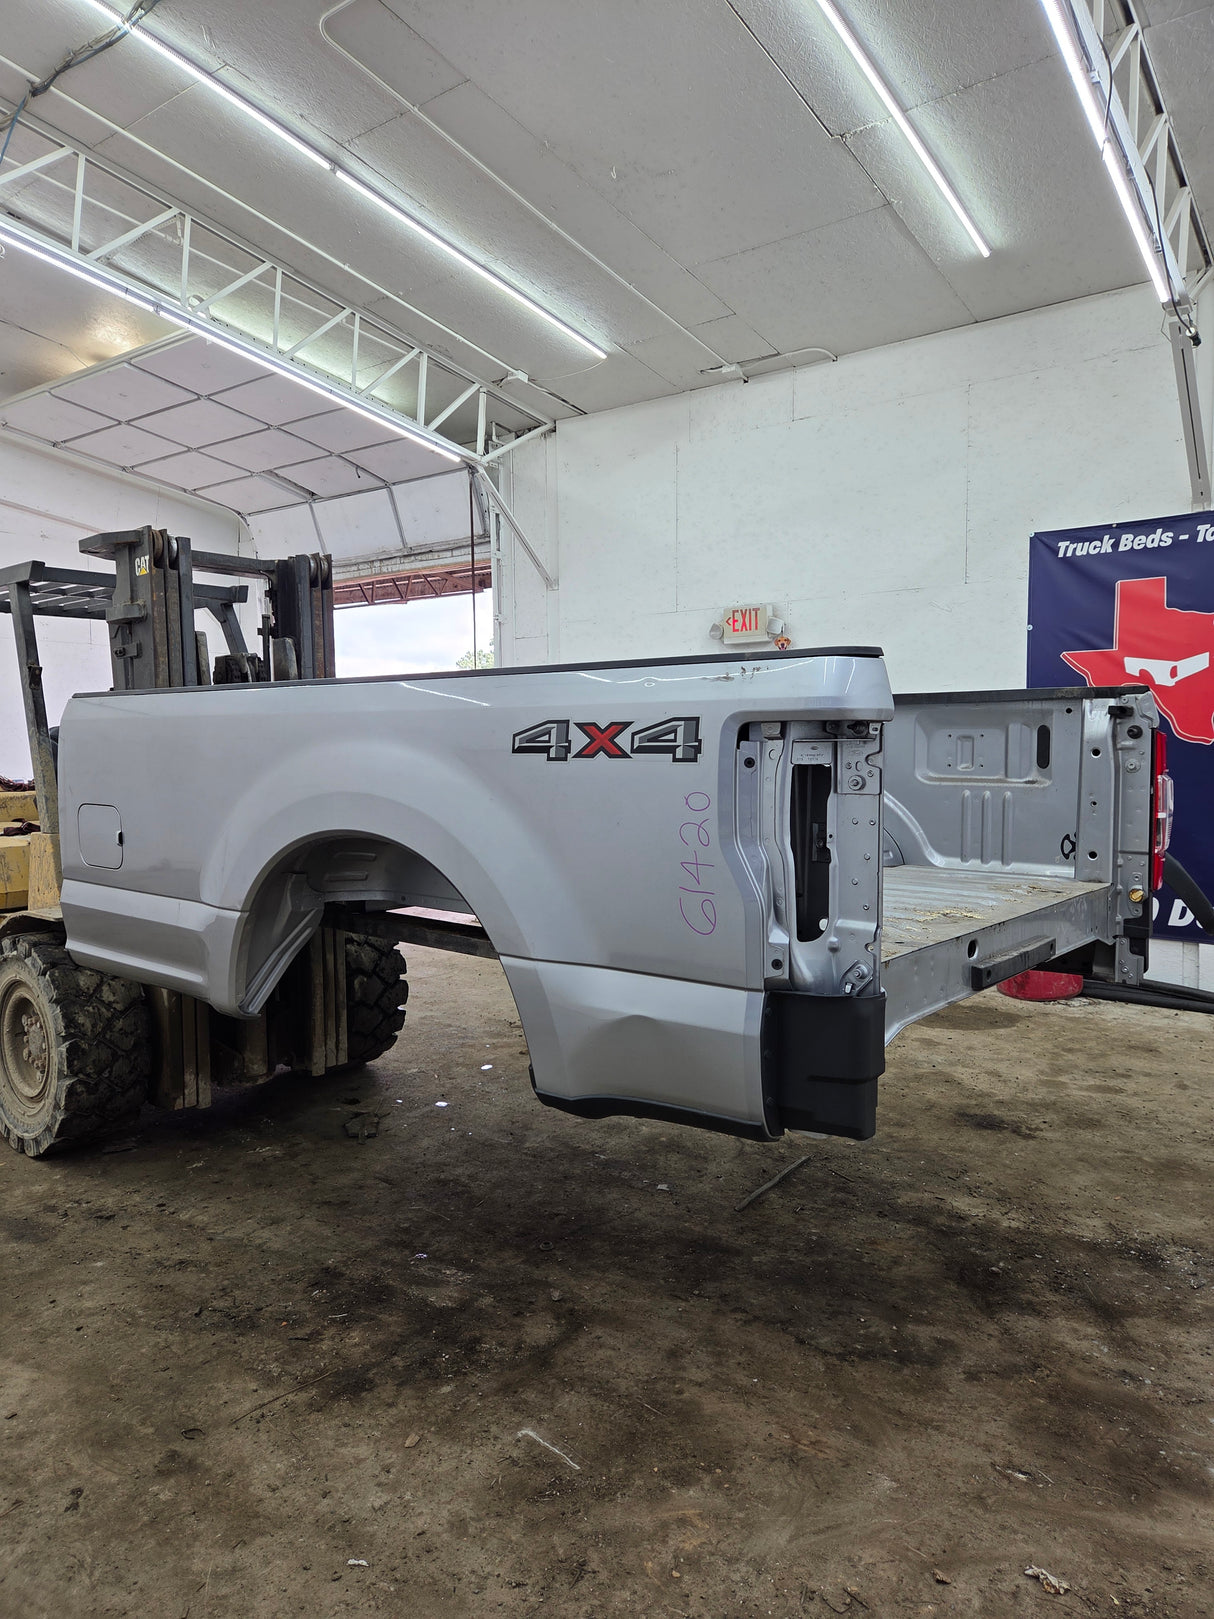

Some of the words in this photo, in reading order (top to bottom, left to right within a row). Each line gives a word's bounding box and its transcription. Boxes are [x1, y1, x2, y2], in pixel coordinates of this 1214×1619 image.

[1057, 535, 1115, 558] Truck
[1118, 528, 1174, 552] Beds
[135, 555, 150, 576] CAT
[732, 608, 760, 632] EXIT
[511, 716, 702, 763] 4X4
[679, 791, 717, 936] 61420
